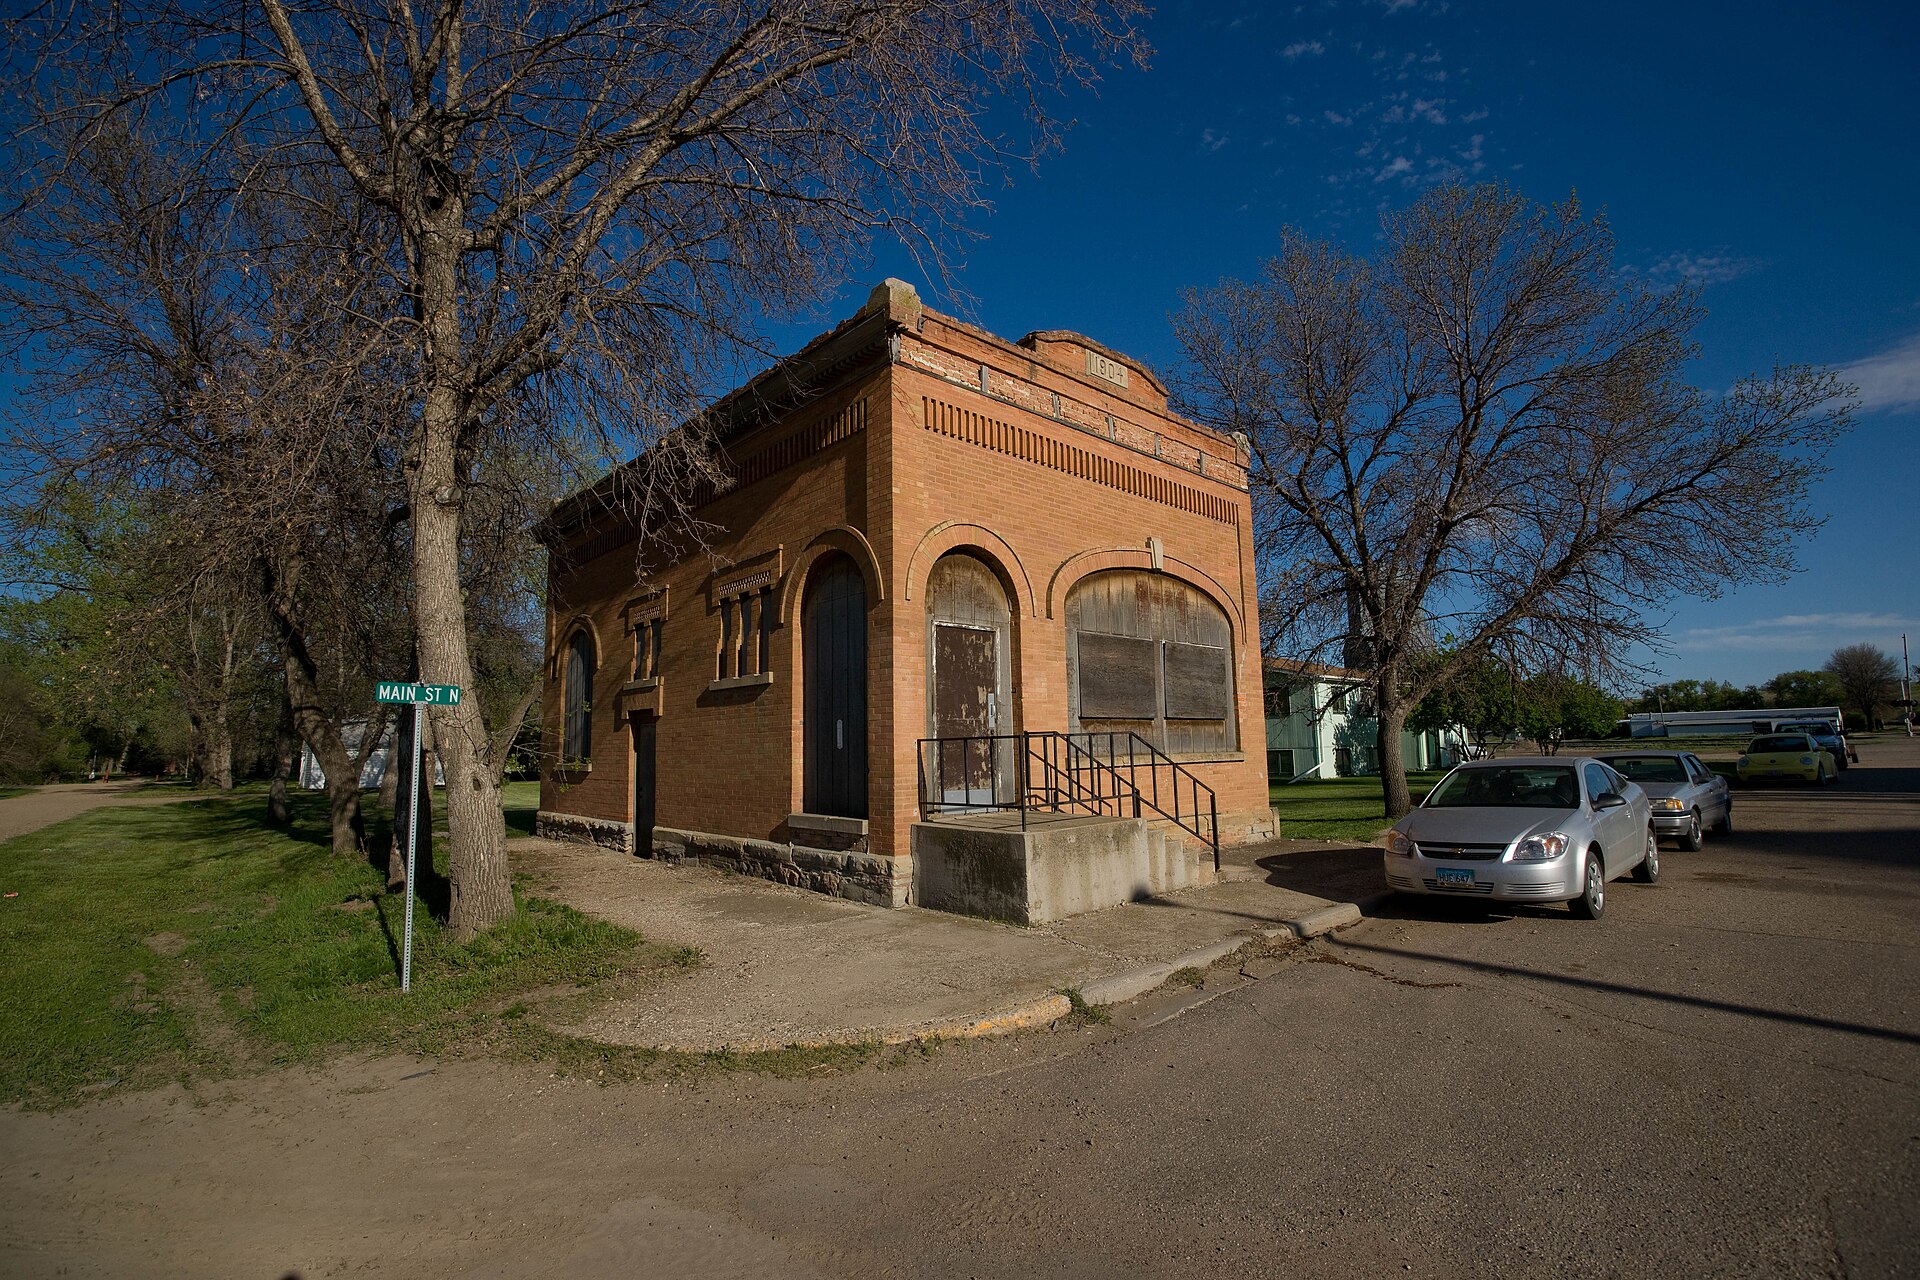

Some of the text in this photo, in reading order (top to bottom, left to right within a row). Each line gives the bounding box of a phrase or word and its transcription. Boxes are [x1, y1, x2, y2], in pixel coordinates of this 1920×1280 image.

[1095, 356, 1124, 384] 1904
[378, 685, 459, 703] MAIN ST N
